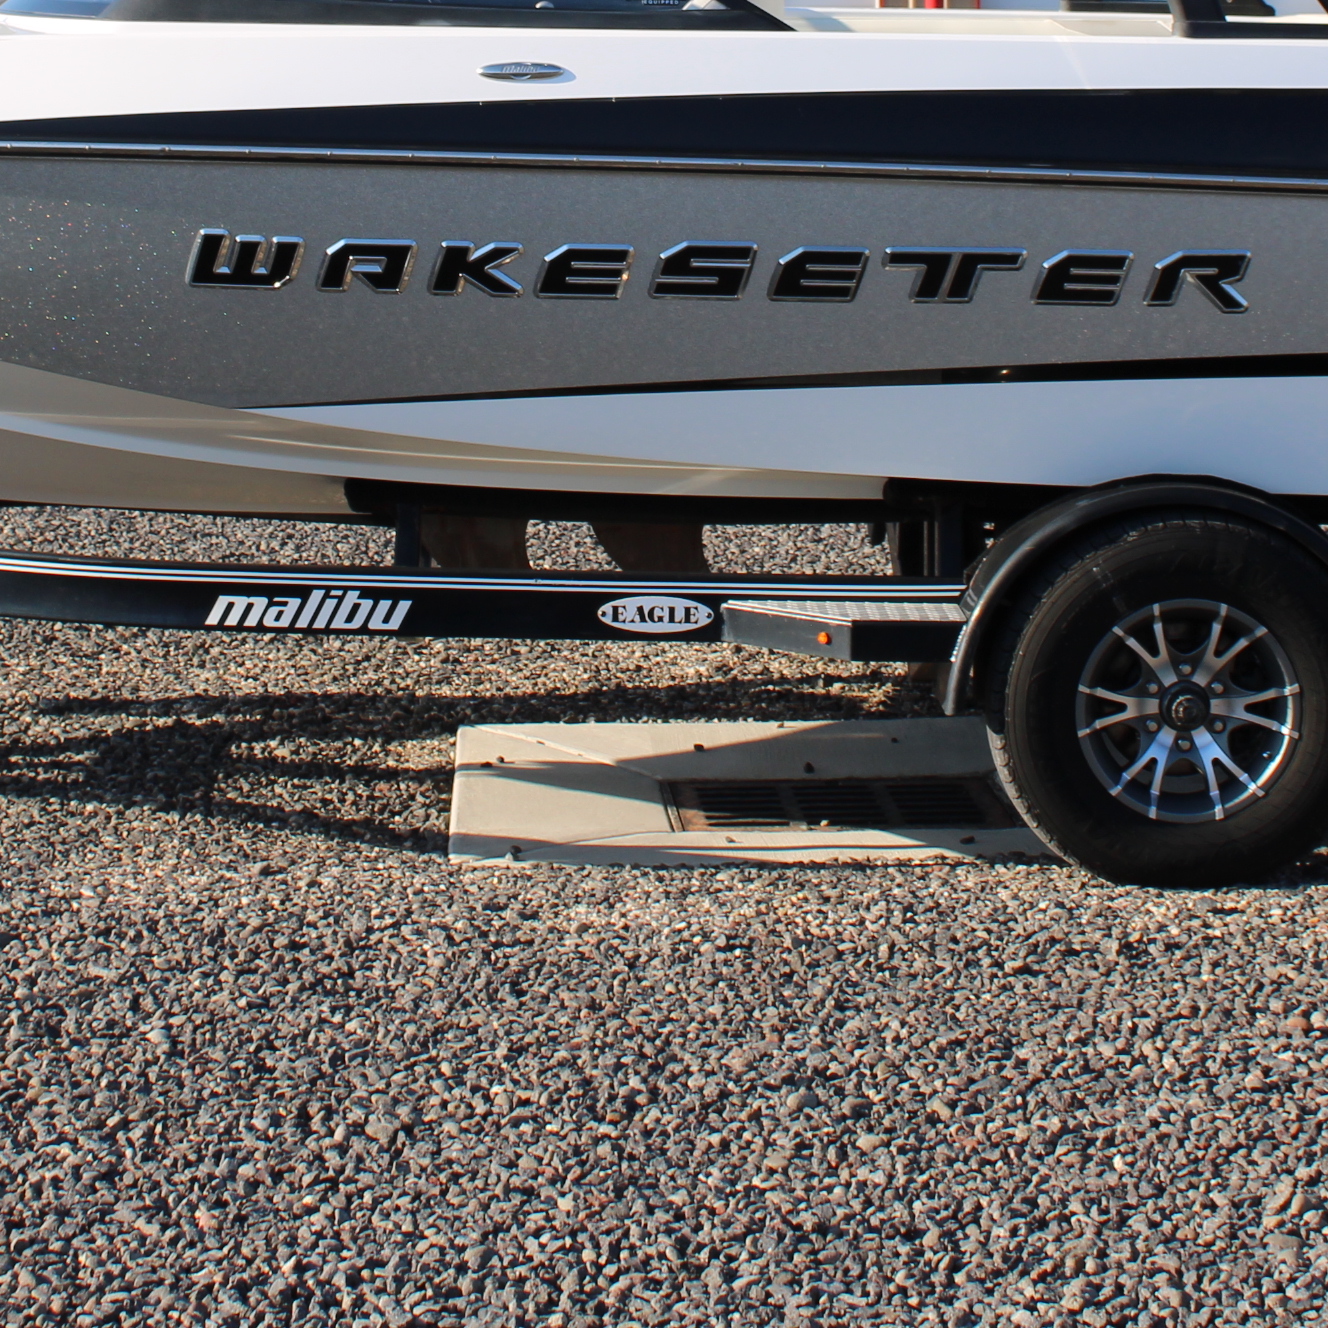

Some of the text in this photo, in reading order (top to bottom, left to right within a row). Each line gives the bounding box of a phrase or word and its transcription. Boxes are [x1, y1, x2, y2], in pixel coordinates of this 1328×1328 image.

[186, 228, 1253, 314] WAKESETTER
[204, 589, 413, 630] malibu
[610, 604, 700, 625] EAGLE
